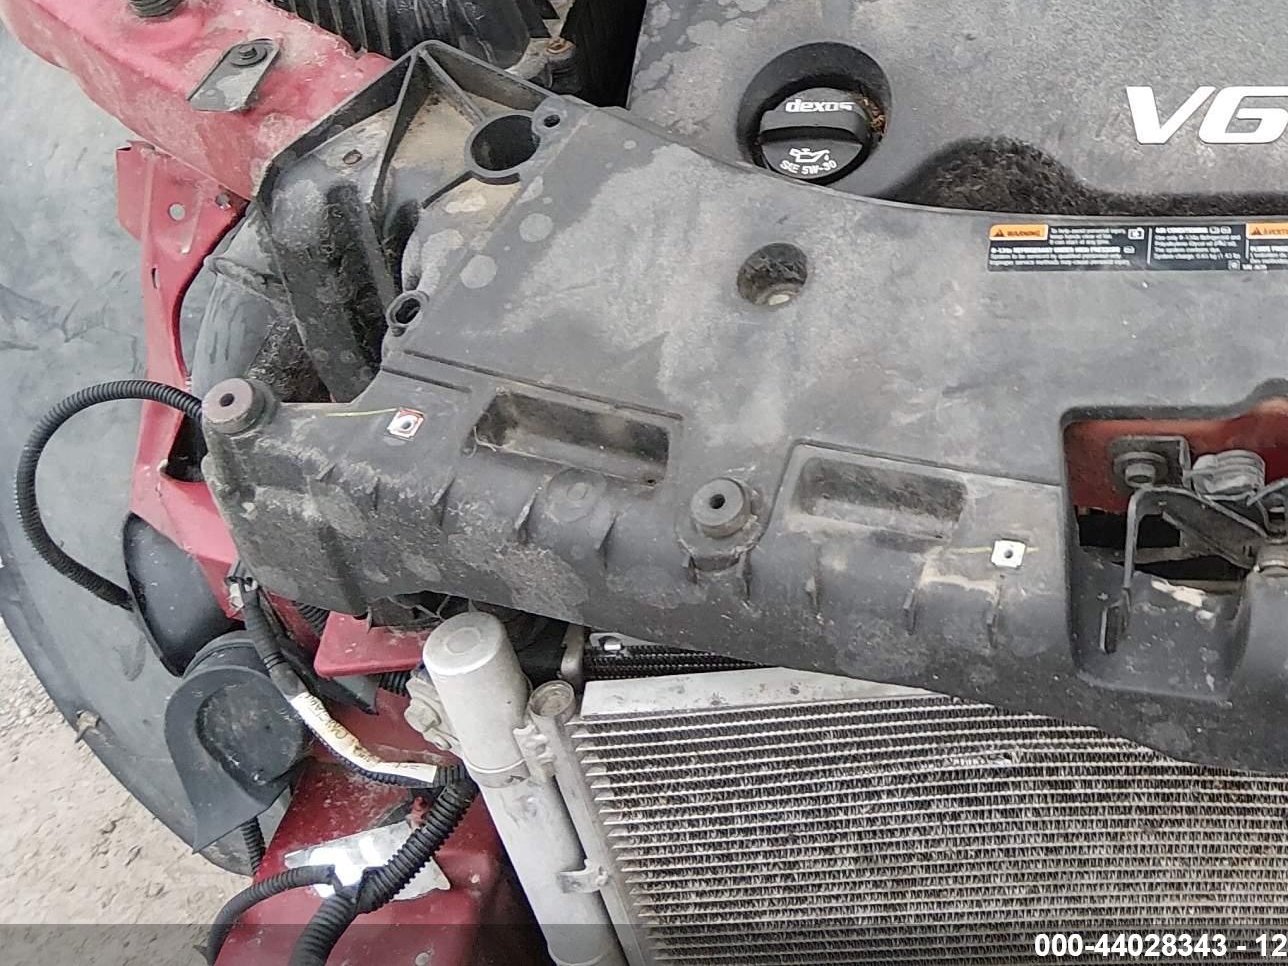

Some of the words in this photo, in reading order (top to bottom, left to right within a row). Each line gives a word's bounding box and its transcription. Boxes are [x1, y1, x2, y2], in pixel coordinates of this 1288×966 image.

[785, 98, 856, 113] dexos
[780, 159, 800, 174] SAE
[801, 160, 838, 175] 5W-30
